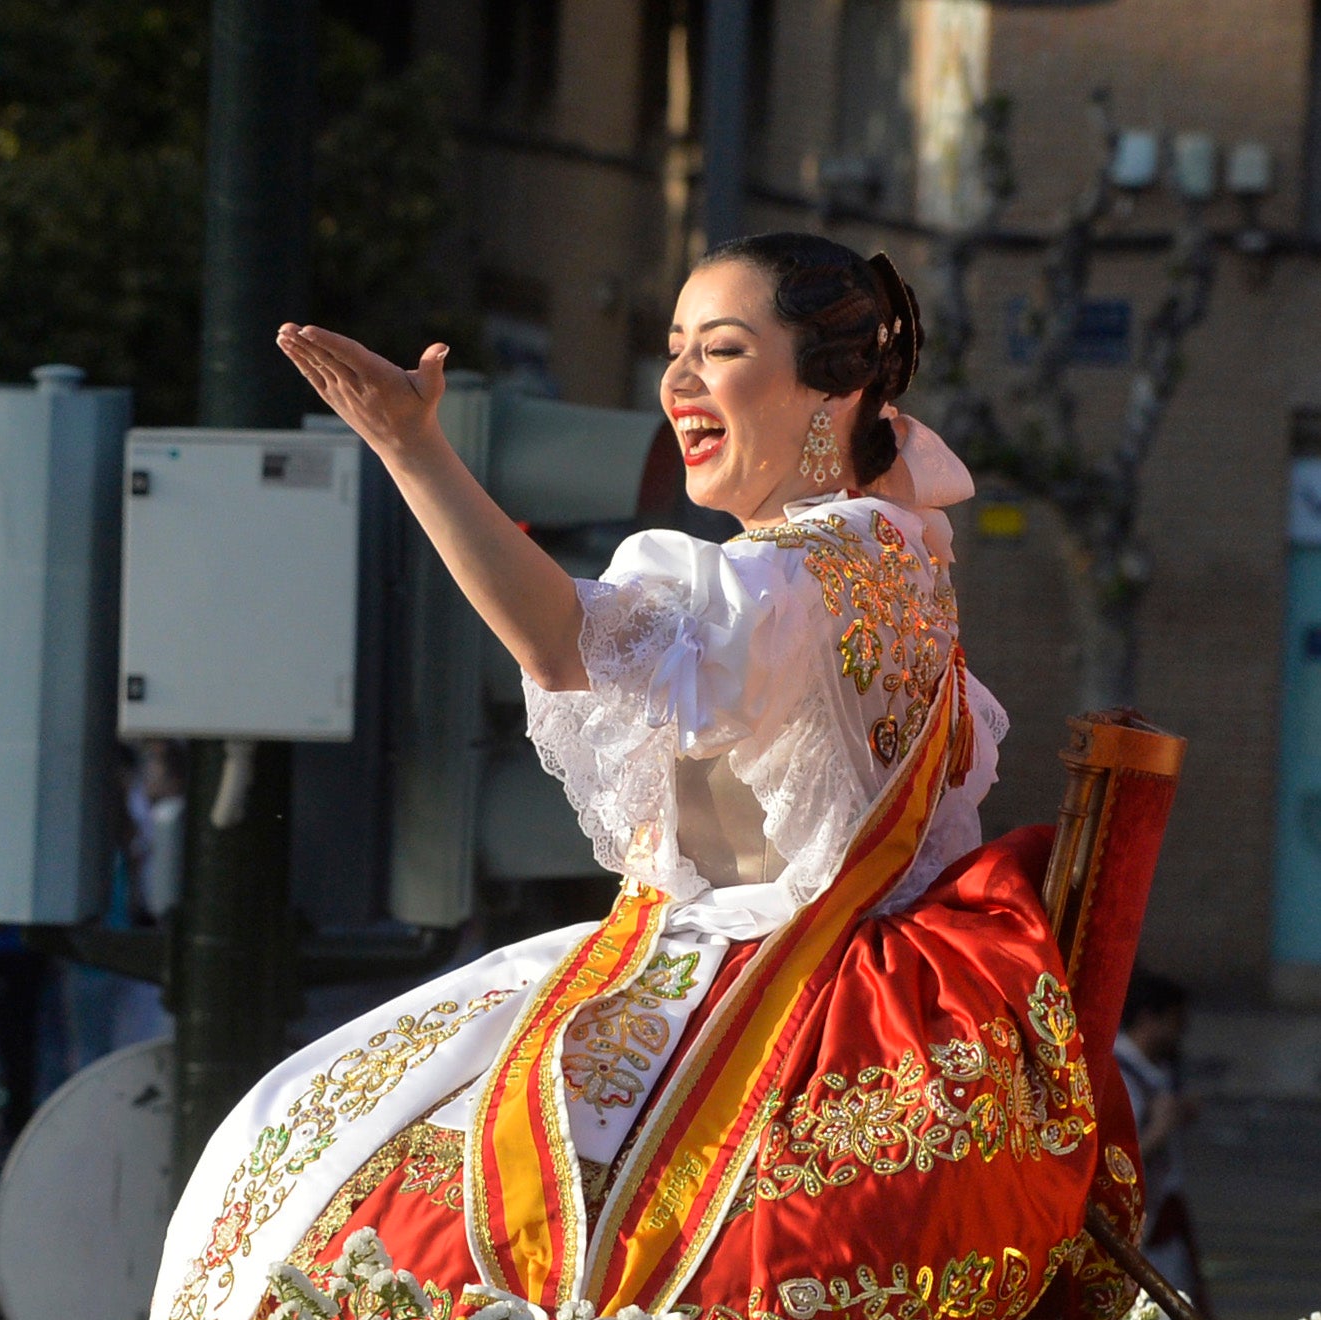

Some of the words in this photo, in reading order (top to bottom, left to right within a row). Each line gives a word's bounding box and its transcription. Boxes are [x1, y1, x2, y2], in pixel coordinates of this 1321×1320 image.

[588, 936, 621, 963] de
[567, 968, 609, 991] la
[649, 1151, 703, 1230] Andrea
